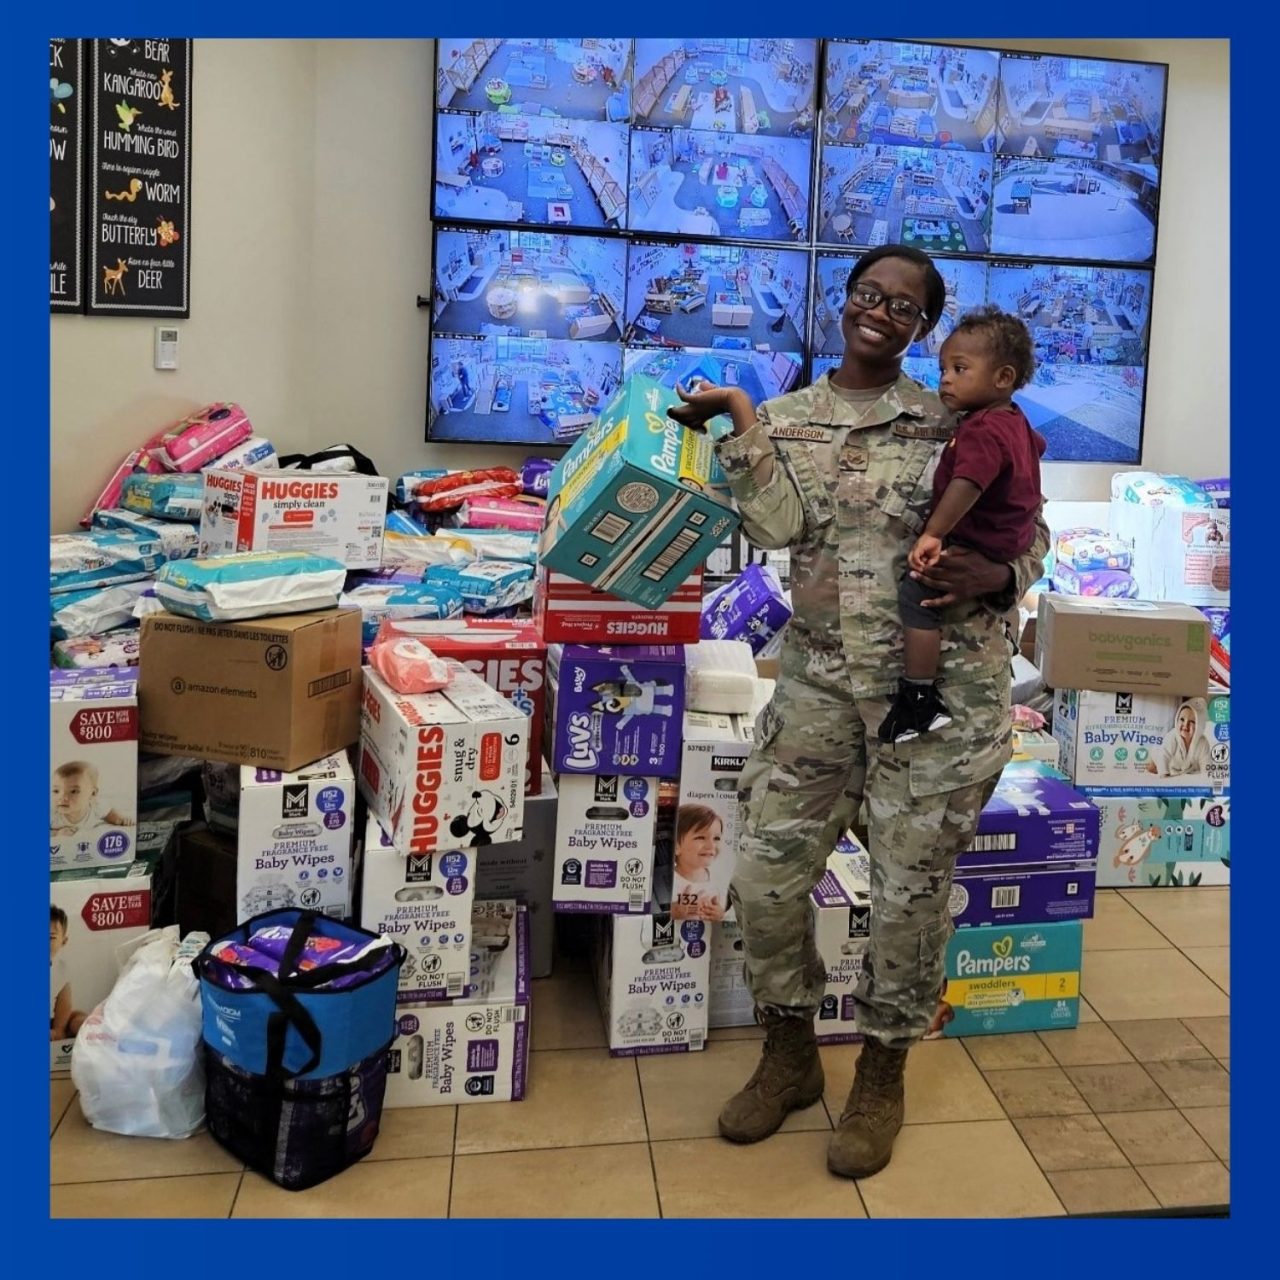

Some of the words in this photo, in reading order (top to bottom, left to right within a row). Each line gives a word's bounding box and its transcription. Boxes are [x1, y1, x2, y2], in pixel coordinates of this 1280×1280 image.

[145, 40, 170, 64] BEAR
[103, 71, 161, 101] KANGAROO
[103, 130, 155, 156] HUMMING
[157, 138, 179, 159] BIRD
[145, 181, 180, 204] WORM
[102, 223, 158, 247] BUTTERFLY
[138, 269, 163, 289] DEER
[772, 427, 825, 440] ANDERSON
[562, 417, 614, 485] Pampers
[206, 473, 243, 493] HUGGIES
[223, 491, 240, 501] simply
[261, 481, 339, 500] HUGGIES
[273, 500, 302, 510] simply
[303, 500, 326, 508] clean
[154, 622, 164, 631] DO
[164, 623, 176, 632] NOT
[176, 623, 194, 634] FLUSH
[206, 626, 217, 637] PAS
[217, 628, 234, 638] JETER
[250, 631, 260, 641] LES
[260, 632, 289, 643] TOILETTES
[606, 621, 669, 636] HUGGIES
[187, 683, 220, 694] amazon
[220, 683, 258, 699] elements
[79, 710, 116, 726] SAVE
[1104, 715, 1147, 724] PREMIUM
[79, 724, 112, 740] $800
[1084, 729, 1119, 746] Baby
[1120, 730, 1164, 747] Wipes
[453, 737, 465, 747] &
[504, 733, 520, 746] 6
[250, 746, 267, 759] 810
[465, 747, 479, 770] dry
[453, 747, 465, 782] snug
[322, 790, 338, 799] 1152
[410, 725, 445, 855] HUGGIES
[686, 791, 715, 800] diapers
[277, 829, 294, 838] Baby
[295, 828, 315, 836] Wipes
[574, 829, 616, 837] FRAGRANCE
[584, 823, 623, 831] PREMIUM
[104, 835, 123, 848] 176
[274, 839, 316, 850] PREMIUM
[567, 836, 598, 850] Baby
[601, 836, 638, 851] Wipes
[261, 846, 308, 857] FRAGRANCE
[309, 845, 329, 853] FREE
[255, 857, 289, 871] Baby
[292, 852, 335, 868] Wipes
[445, 855, 461, 863] 1152
[622, 882, 644, 890] FLUSH
[91, 896, 128, 912] SAVE
[128, 895, 142, 903] MORE
[677, 893, 699, 905] 132
[396, 904, 439, 914] PREMIUM
[91, 911, 124, 927] $800
[384, 912, 431, 921] FRAGRANCE
[378, 923, 411, 935] Baby
[414, 920, 456, 933] Wipes
[956, 949, 1031, 977] Pampers
[416, 974, 428, 982] DO
[429, 973, 445, 982] NOT
[634, 974, 675, 983] FRAGRANCE
[644, 967, 681, 977] PREMIUM
[824, 972, 853, 985] Baby
[418, 980, 442, 988] FLUSH
[628, 982, 657, 996] Baby
[660, 980, 697, 993] Wipes
[968, 979, 1016, 991] swaddlers
[1058, 977, 1066, 989] 2
[485, 1024, 493, 1036] DO
[661, 1030, 675, 1038] DO
[441, 1020, 457, 1061] Wipes
[664, 1035, 685, 1043] FLUSH
[425, 1040, 433, 1080] PREMIUM
[432, 1049, 440, 1089] FRAGRANCE
[440, 1062, 455, 1095] Baby
